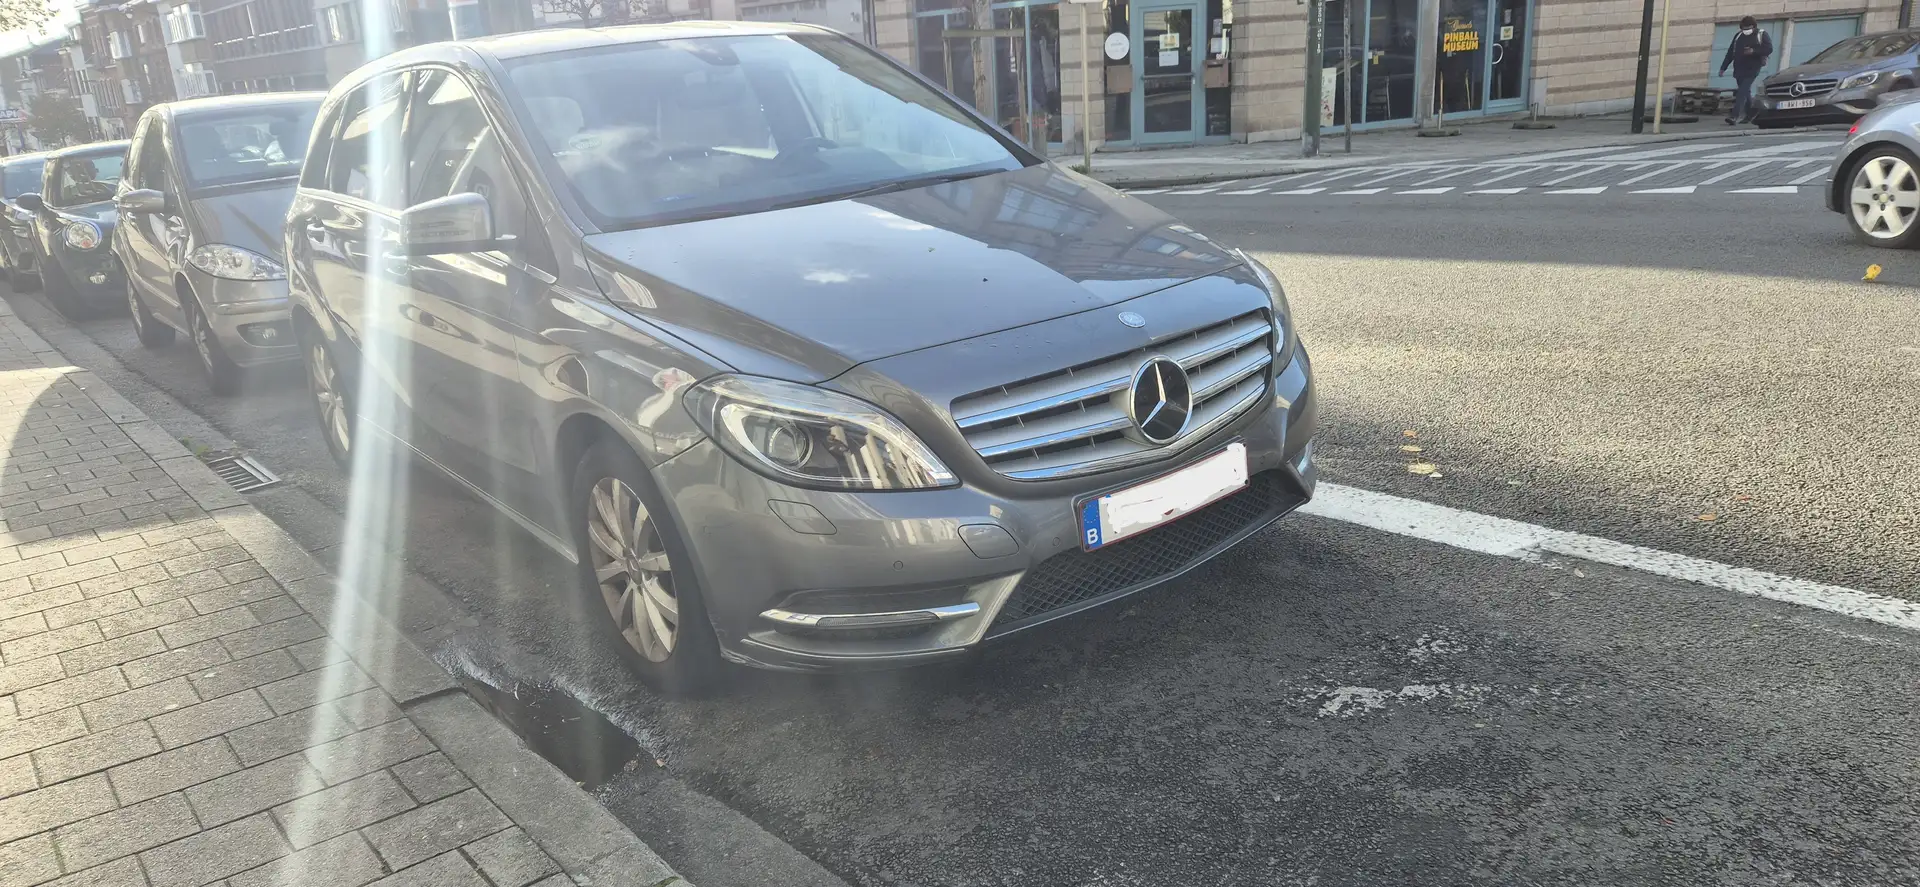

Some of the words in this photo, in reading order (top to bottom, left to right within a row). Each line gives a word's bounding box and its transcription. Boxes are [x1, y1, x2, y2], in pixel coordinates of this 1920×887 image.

[1444, 31, 1479, 43] PINBALL
[1443, 40, 1479, 53] MUSEUM
[1087, 528, 1098, 545] B
